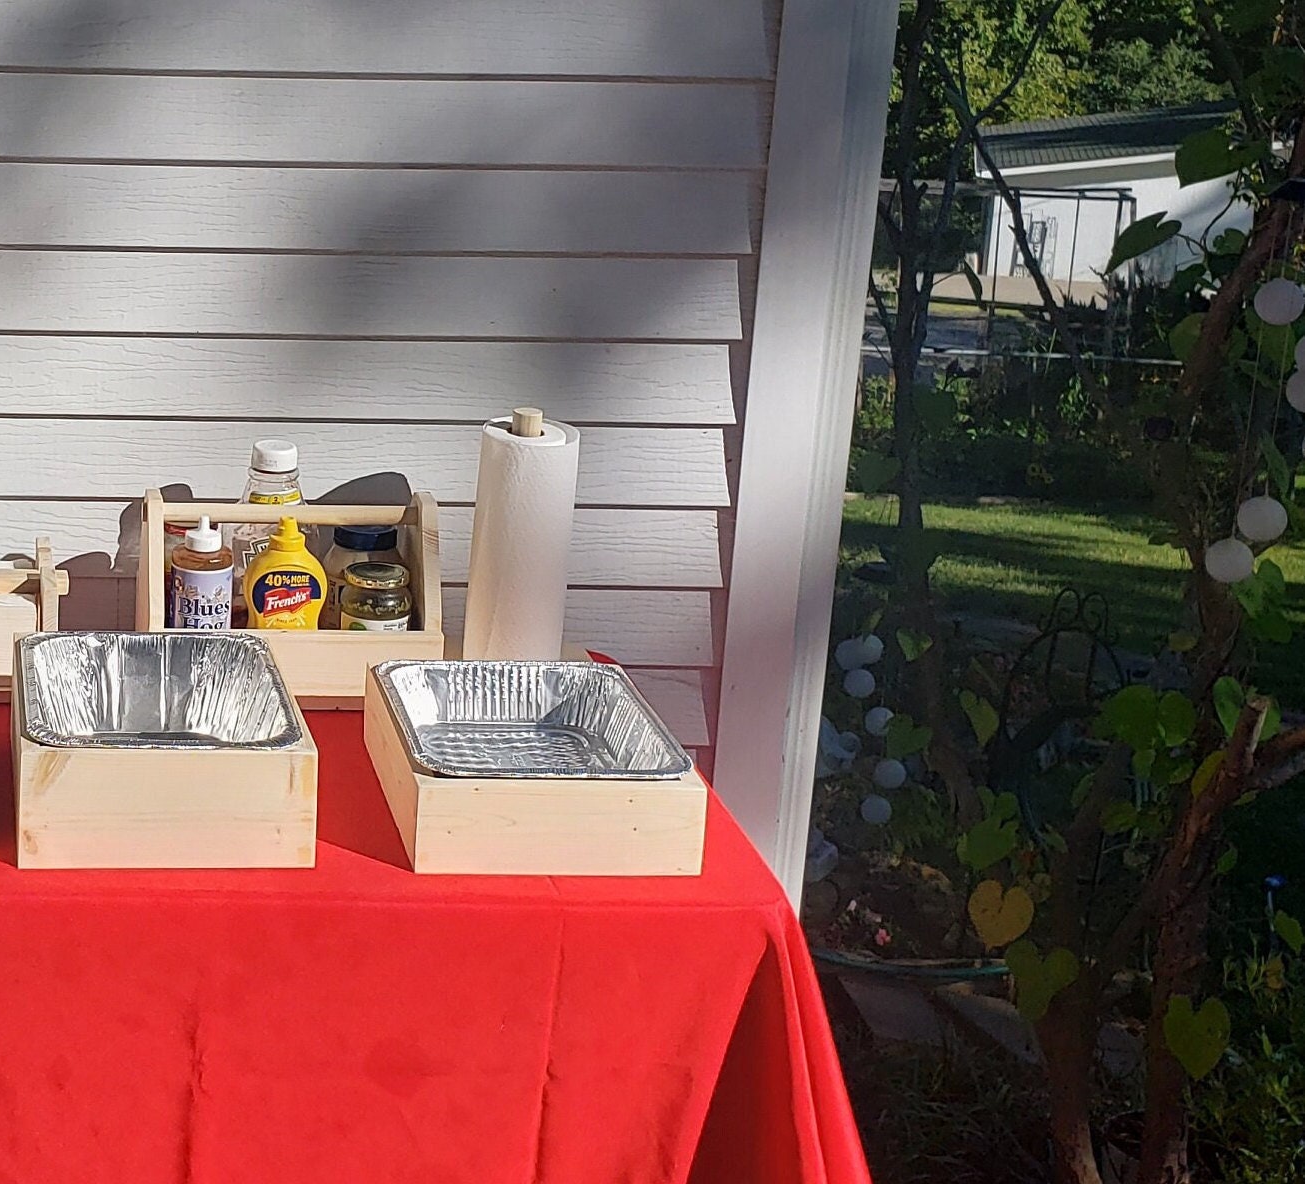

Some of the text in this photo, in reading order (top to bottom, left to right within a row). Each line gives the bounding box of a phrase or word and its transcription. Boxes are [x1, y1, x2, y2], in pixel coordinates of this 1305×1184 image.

[264, 574, 310, 587] 40% MORE
[178, 597, 229, 616] Blues
[266, 591, 307, 611] French's
